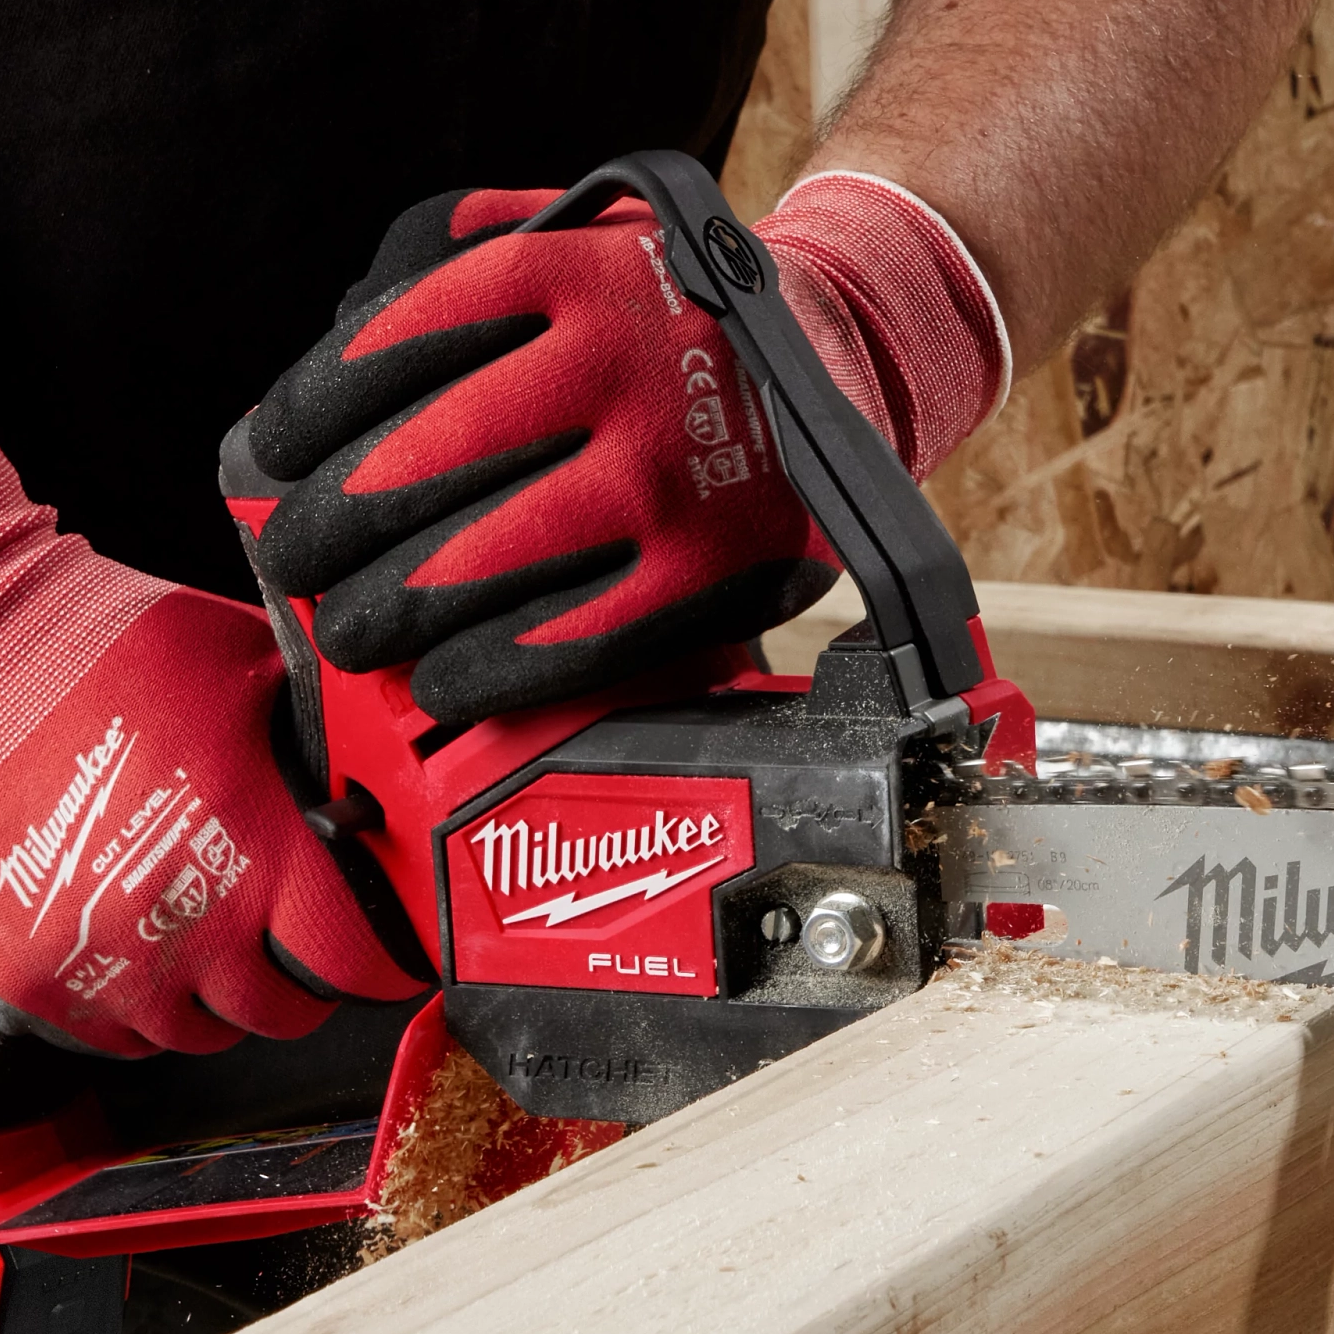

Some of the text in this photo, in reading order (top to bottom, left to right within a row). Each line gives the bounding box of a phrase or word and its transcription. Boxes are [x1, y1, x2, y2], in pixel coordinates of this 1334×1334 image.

[681, 348, 718, 396] CE
[690, 411, 712, 443] A1
[92, 767, 188, 874] CUT LEVEL 1
[471, 810, 724, 896] Milwaukee
[180, 886, 203, 912] A1
[588, 952, 697, 979] FUEL
